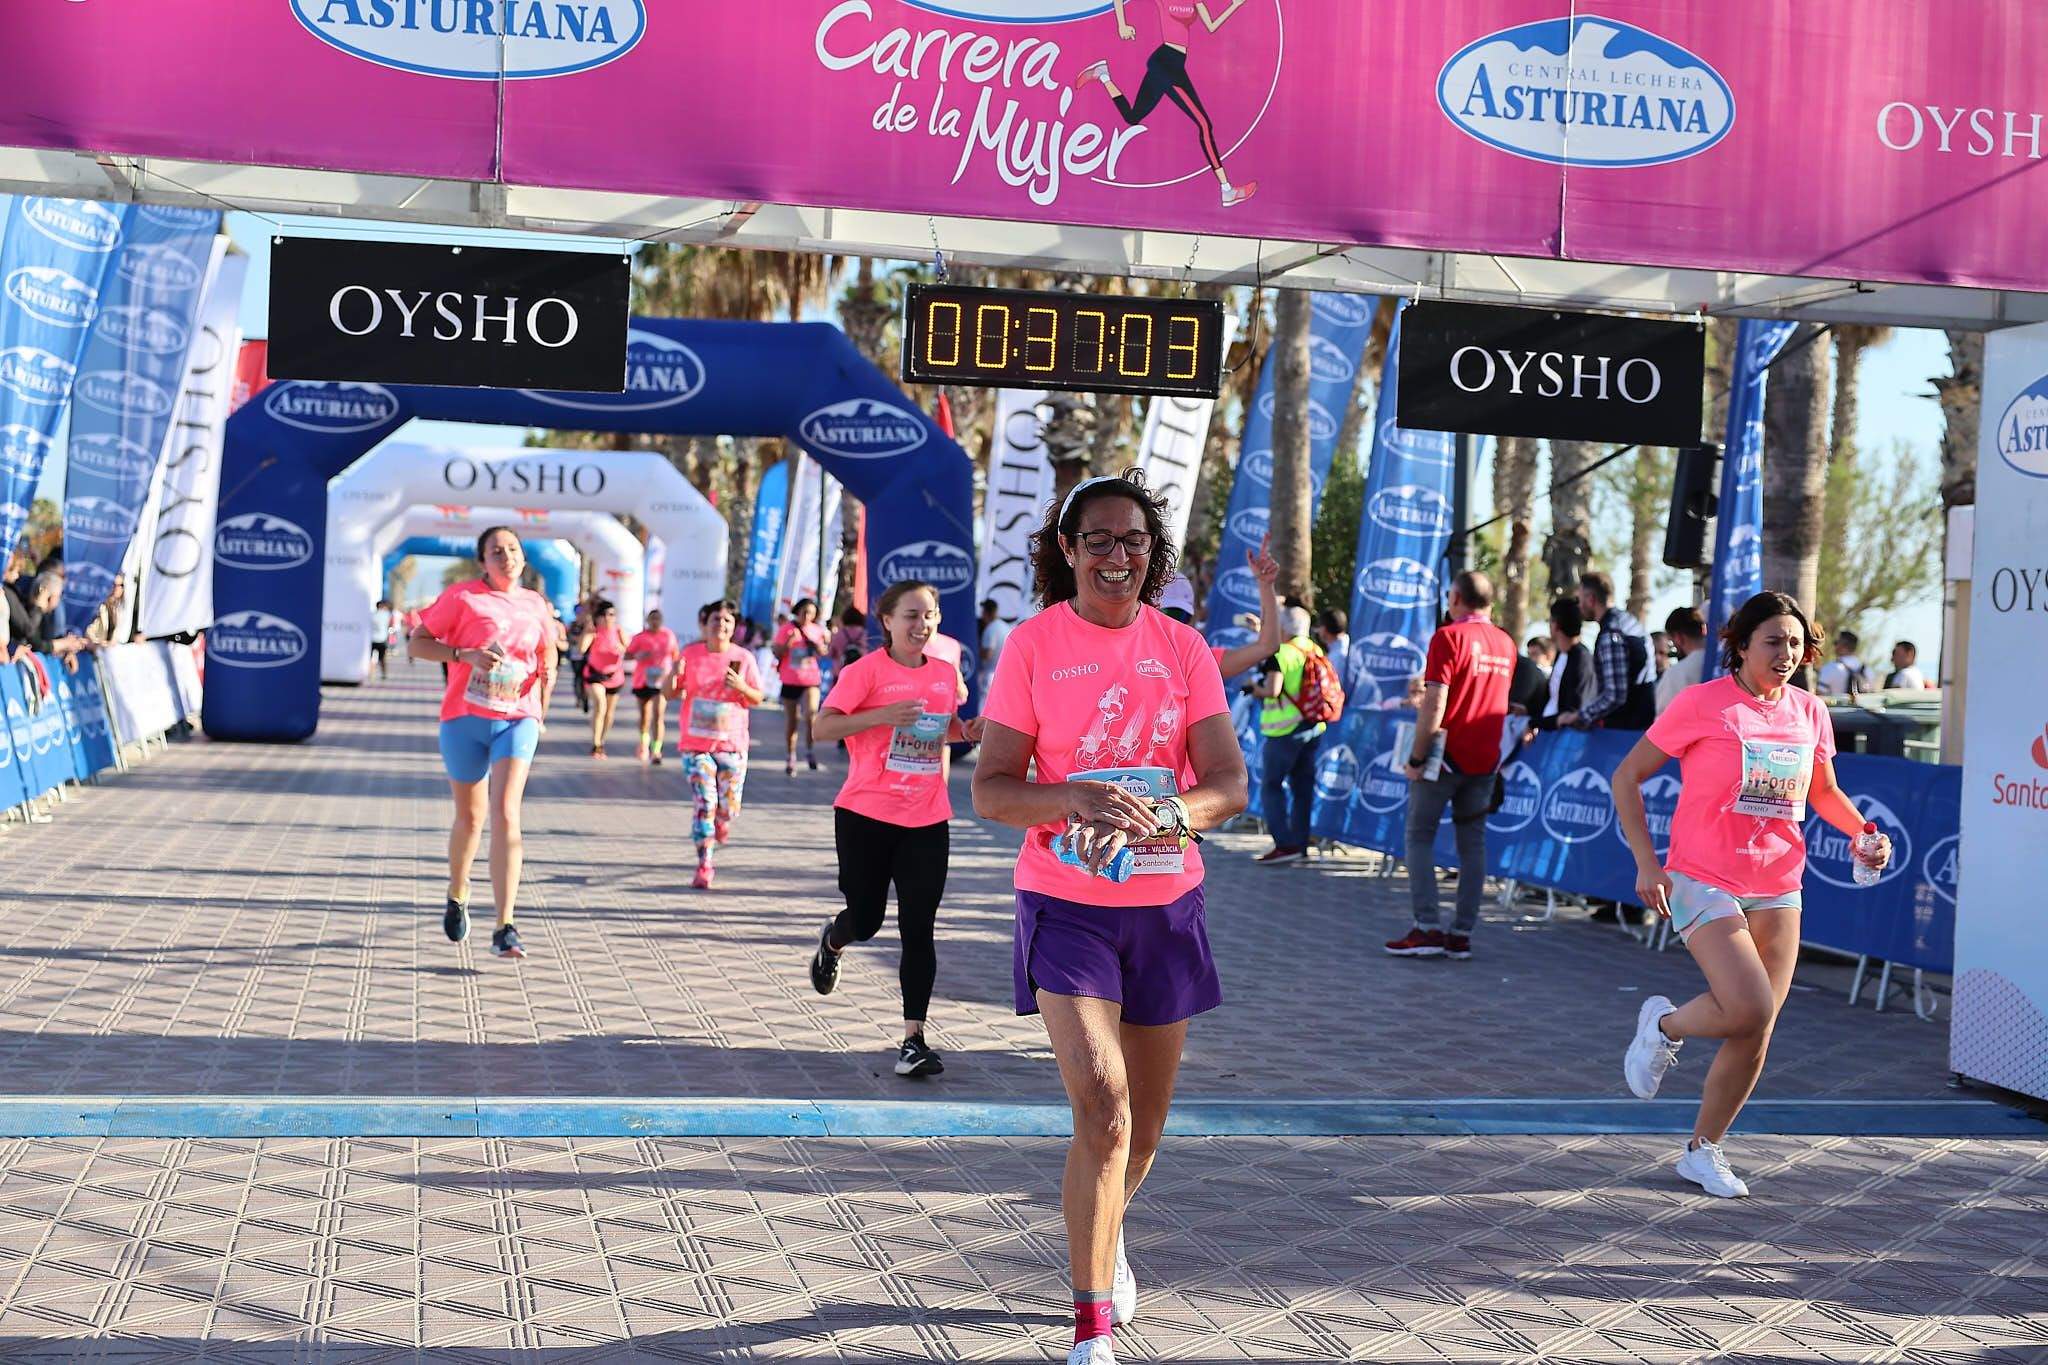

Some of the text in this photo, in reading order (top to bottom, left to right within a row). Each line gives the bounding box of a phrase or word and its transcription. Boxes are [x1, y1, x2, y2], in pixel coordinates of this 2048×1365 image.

[317, 0, 618, 44] ASTURIANA
[815, 0, 1059, 91] Carrera
[1508, 63, 1703, 90] CENTRAL LECHERA
[1459, 62, 1711, 134] ASTURIANA
[872, 82, 1147, 205] de la Mujer
[329, 284, 578, 347] OYSHO
[927, 301, 1199, 379] 00:37:03
[1450, 345, 1661, 404] OYSHO
[273, 391, 389, 419] ASTURIANA
[807, 420, 921, 444] ASTURIANA
[444, 456, 607, 496] OYSHO
[217, 534, 305, 558] ASTURIANA
[1052, 663, 1099, 682] OYSHO
[1547, 791, 1608, 826] ASTURIANA
